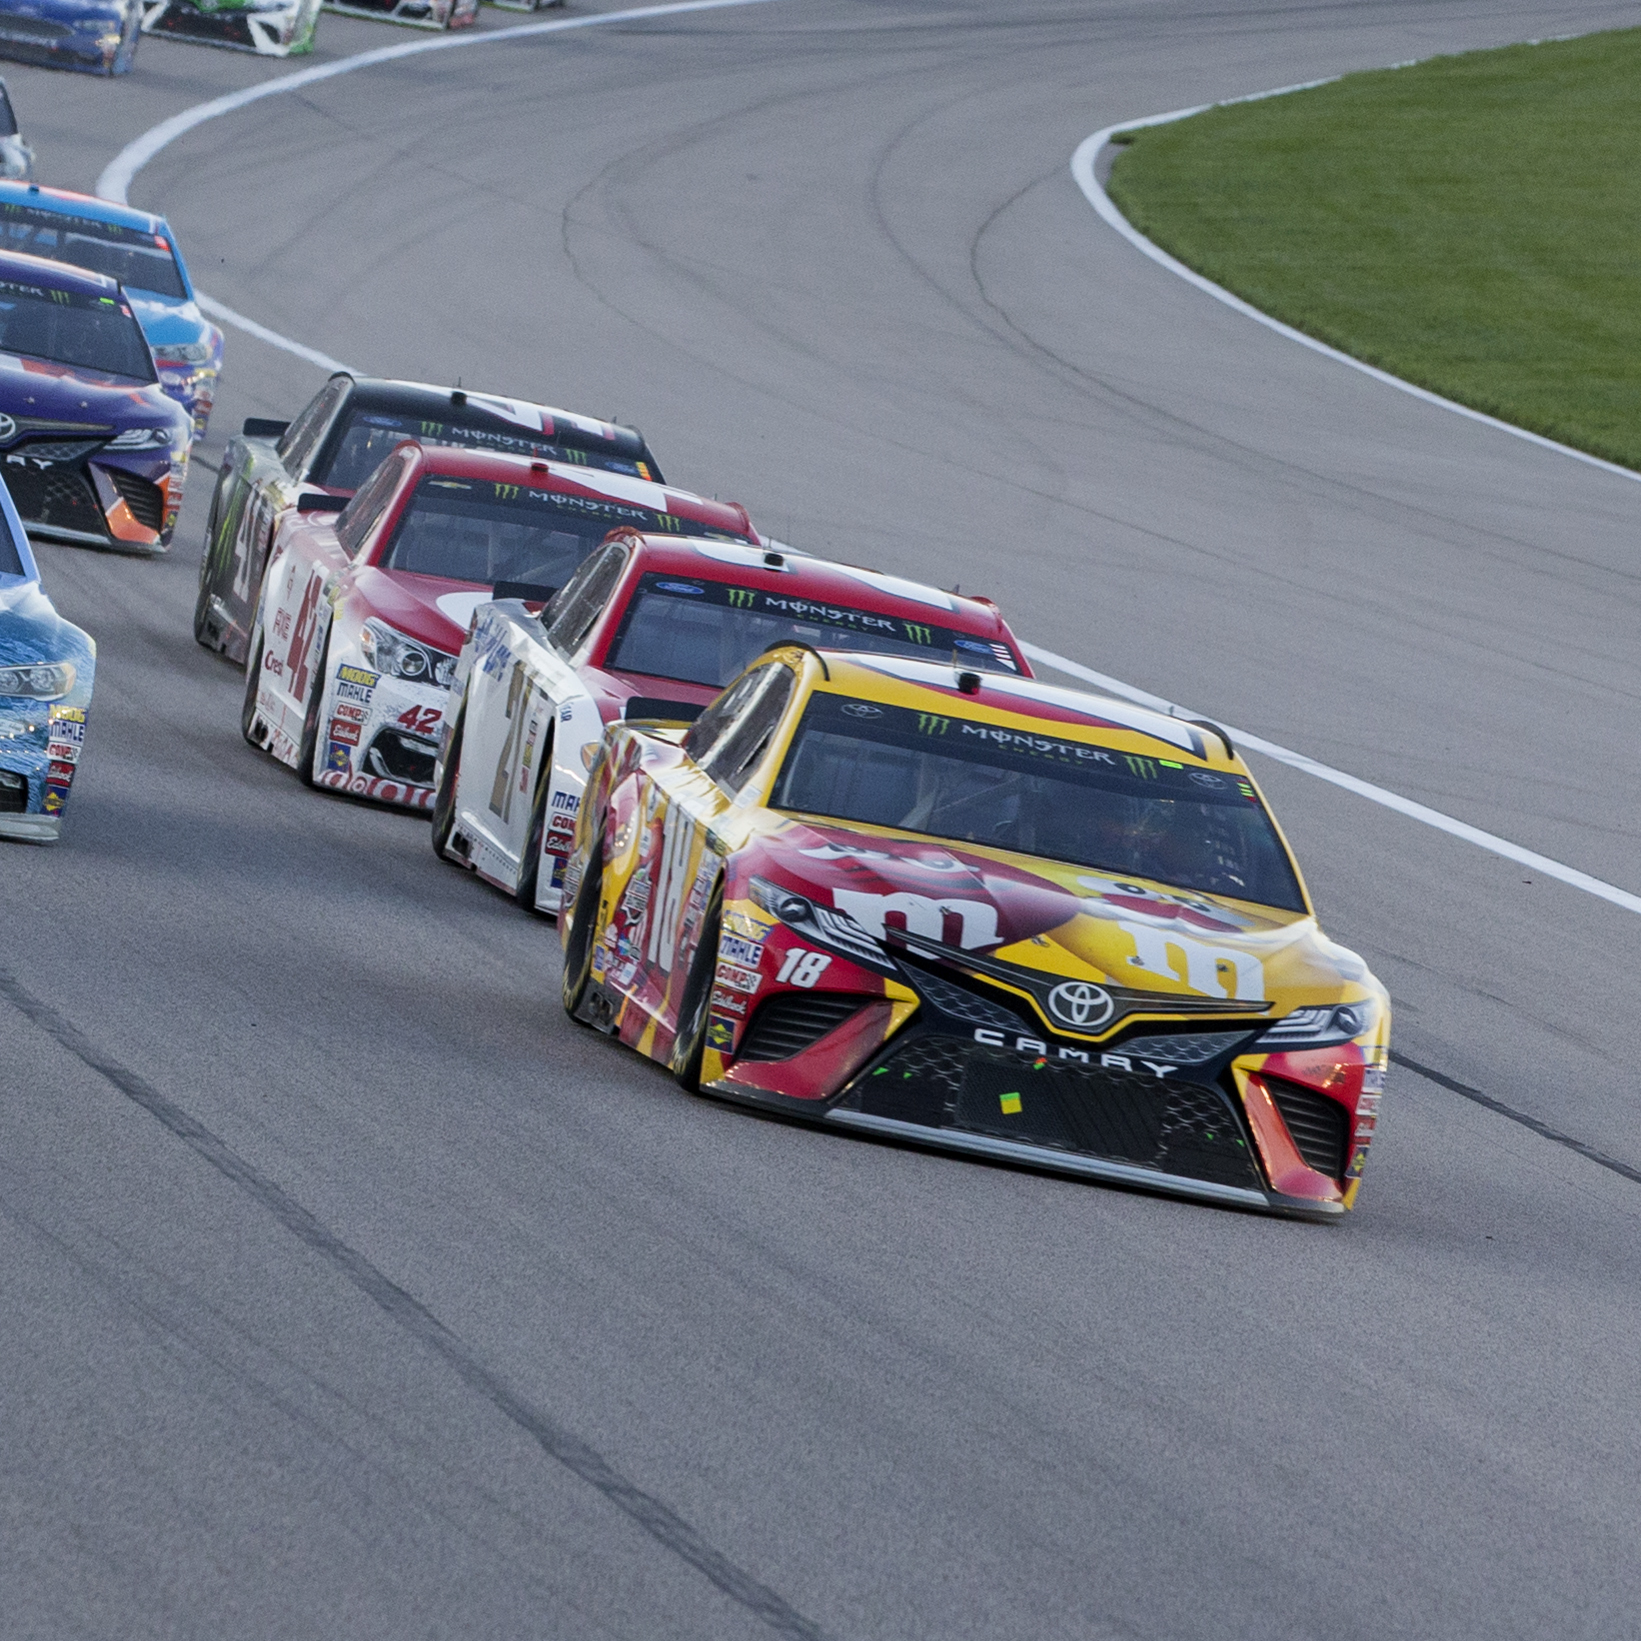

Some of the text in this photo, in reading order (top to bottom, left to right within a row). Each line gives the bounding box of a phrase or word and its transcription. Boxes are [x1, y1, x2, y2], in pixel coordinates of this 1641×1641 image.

[527, 487, 649, 521] MONSTER
[765, 597, 897, 632] MONSTER
[336, 682, 373, 704] MAHLE
[338, 666, 378, 687] MOOG
[50, 721, 85, 743] MAHLE
[396, 704, 443, 735] 42
[961, 723, 1117, 766] MONSTER
[551, 790, 582, 813] MAH
[552, 814, 577, 832] COM
[832, 887, 1005, 960] m
[719, 935, 761, 967] MAHLE
[1115, 920, 1267, 1014] m
[775, 947, 832, 989] 18
[974, 1028, 1179, 1078] CAMRY
